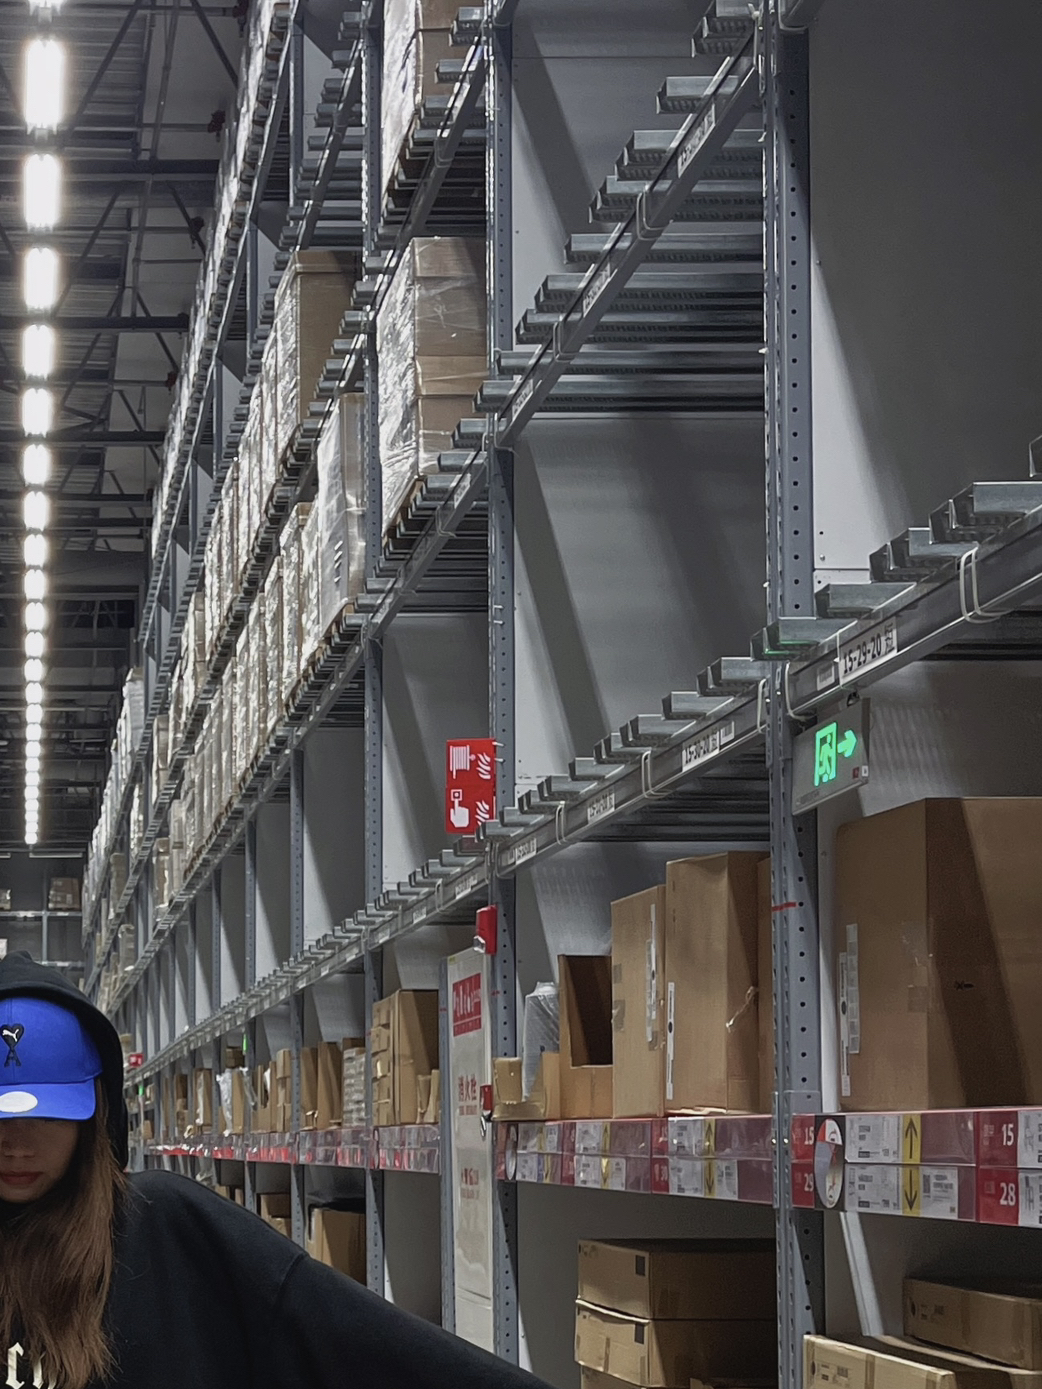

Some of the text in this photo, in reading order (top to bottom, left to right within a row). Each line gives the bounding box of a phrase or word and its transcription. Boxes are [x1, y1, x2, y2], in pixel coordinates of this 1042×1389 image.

[843, 632, 882, 675] 15-29-20
[804, 1126, 815, 1146] 15
[1001, 1123, 1015, 1146] 15
[999, 1182, 1017, 1206] 28
